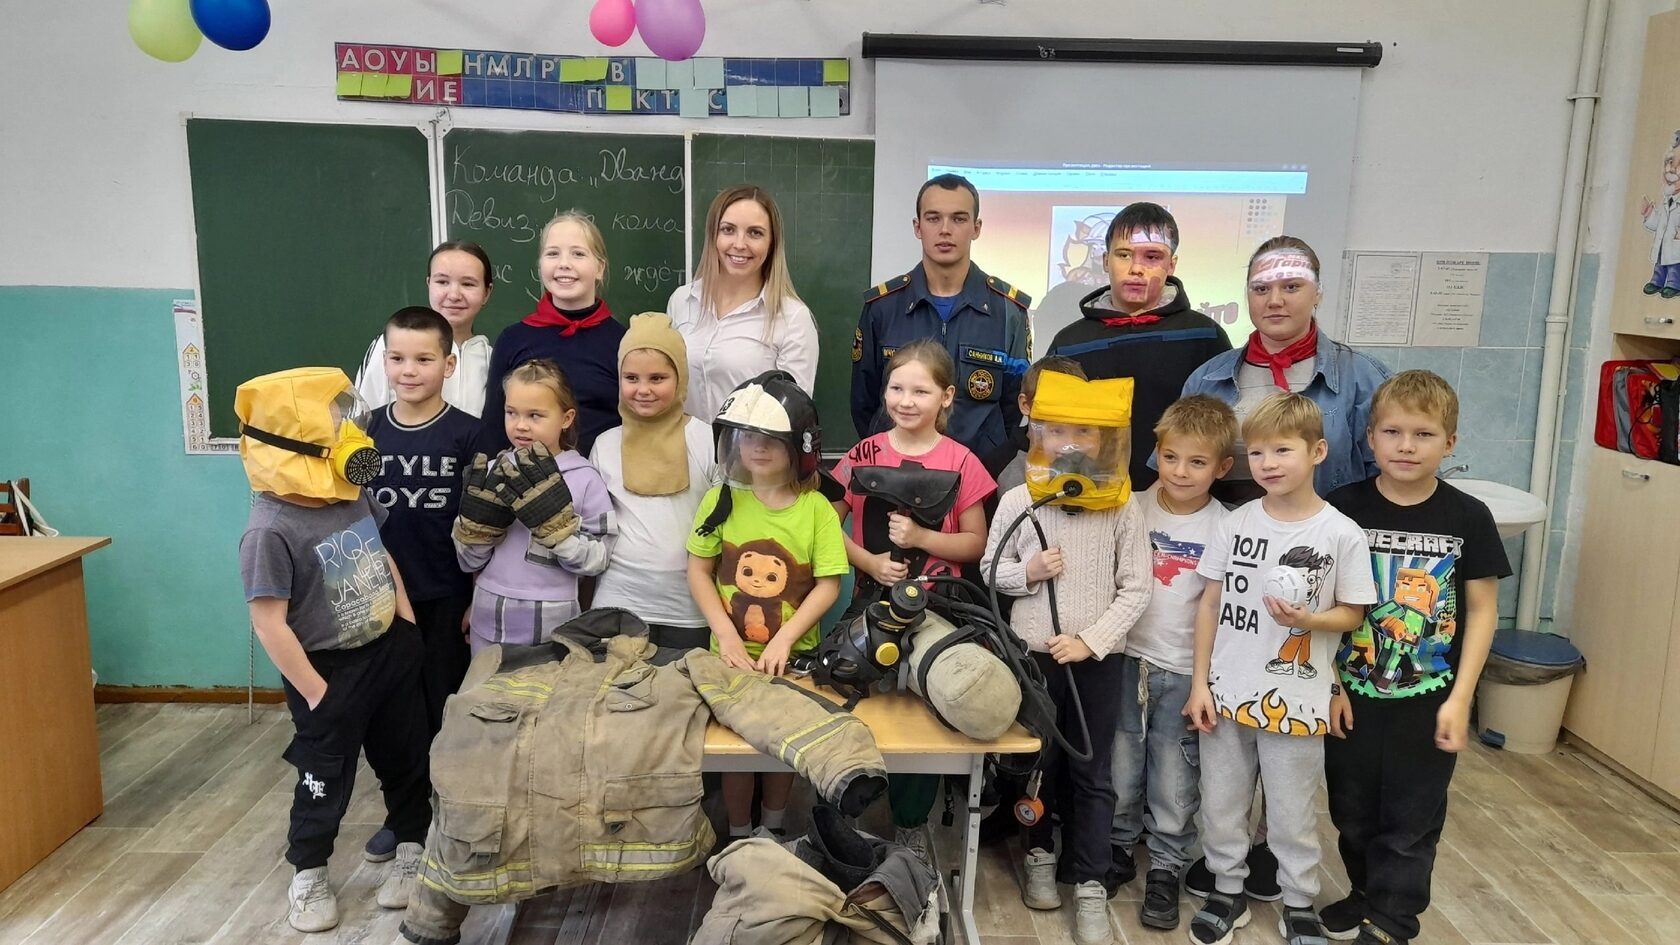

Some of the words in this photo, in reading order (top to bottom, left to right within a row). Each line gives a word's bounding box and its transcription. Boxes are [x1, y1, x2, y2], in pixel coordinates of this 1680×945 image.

[491, 264, 513, 284] ас
[379, 455, 457, 477] TYLE
[368, 486, 452, 509] OYS
[315, 530, 362, 573] RIO
[1362, 529, 1463, 559] NECRAFT
[1225, 571, 1249, 594] ТО
[1219, 602, 1259, 635] АВА
